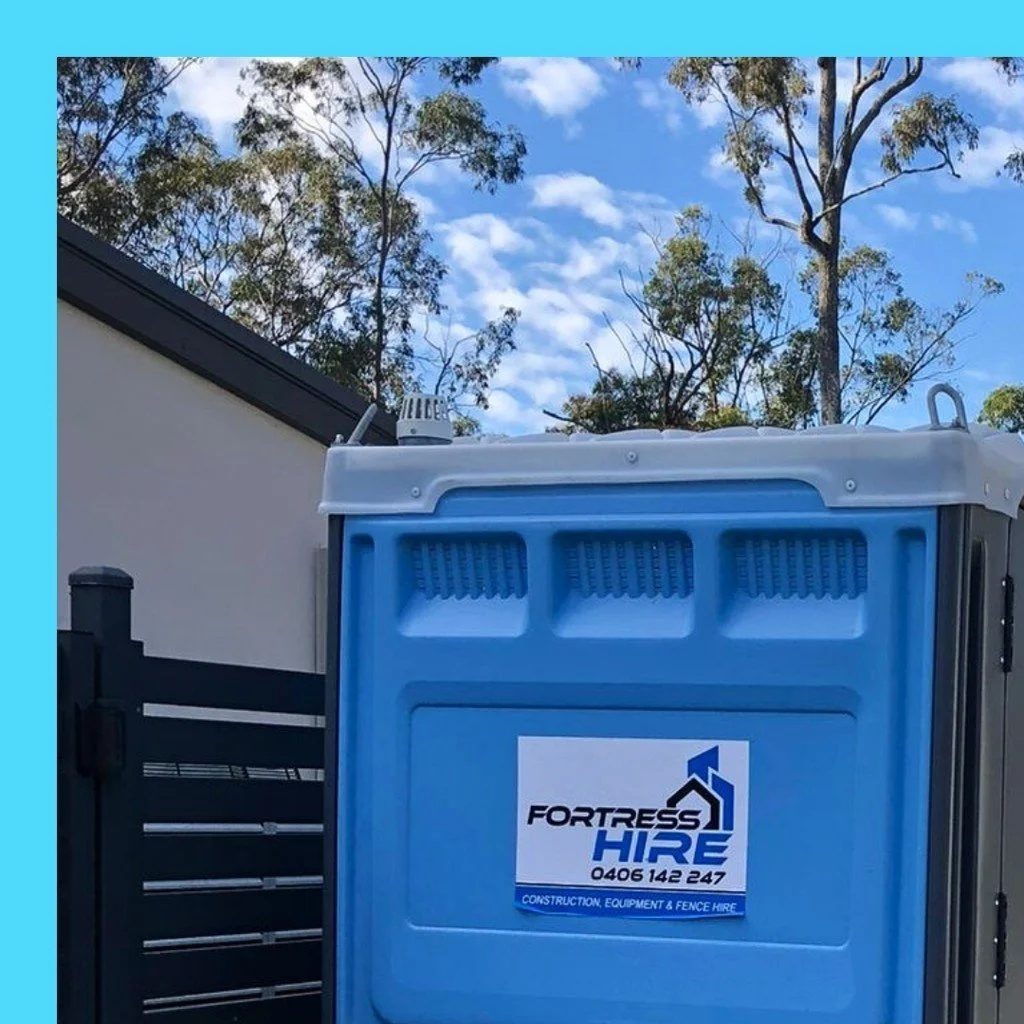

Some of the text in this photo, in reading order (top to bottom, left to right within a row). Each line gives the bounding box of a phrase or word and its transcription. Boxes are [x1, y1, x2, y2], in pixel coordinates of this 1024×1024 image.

[527, 804, 702, 831] FORTRESS
[592, 829, 734, 866] HIRE
[591, 866, 727, 885] 0406 142 247
[521, 894, 737, 913] CONSTRUCTION, EQUIPMENT & FENCE HIRE
